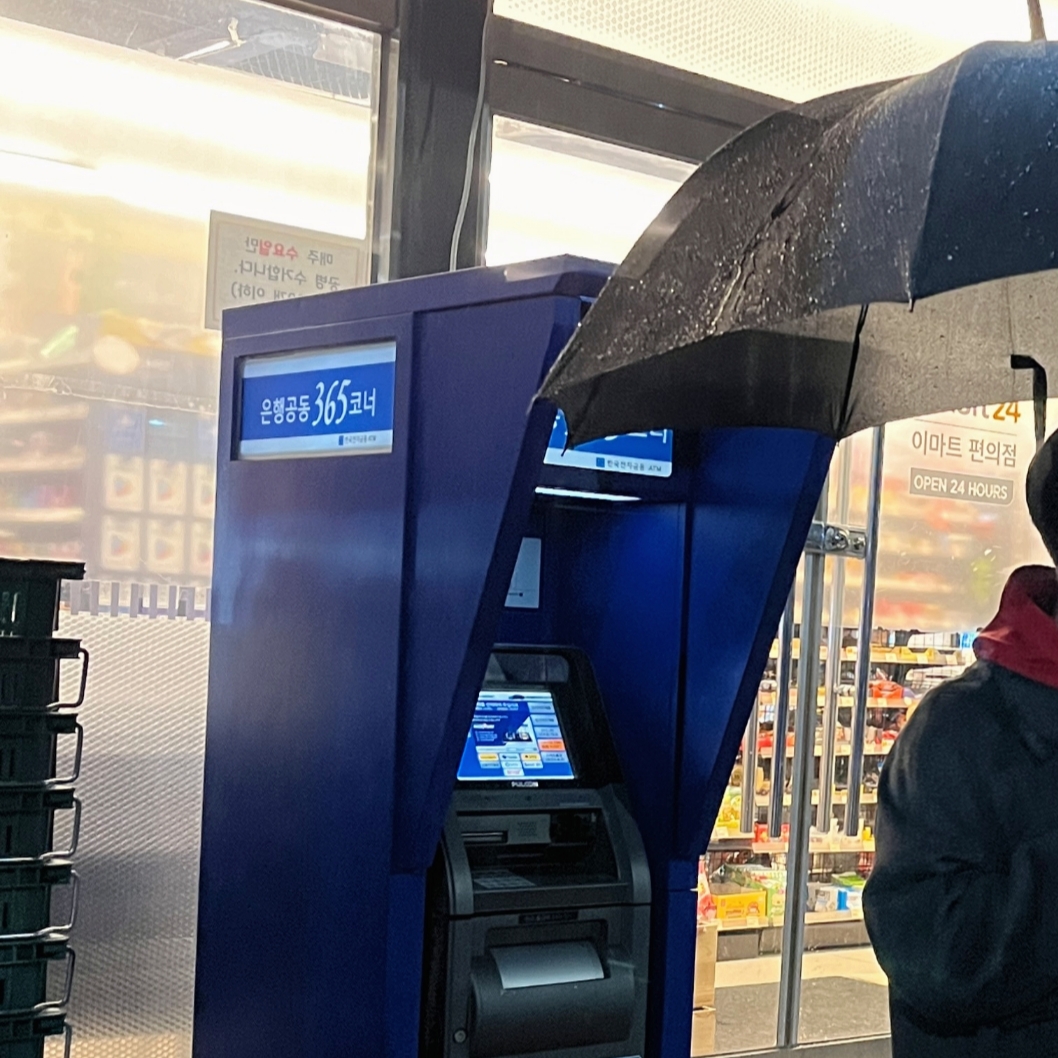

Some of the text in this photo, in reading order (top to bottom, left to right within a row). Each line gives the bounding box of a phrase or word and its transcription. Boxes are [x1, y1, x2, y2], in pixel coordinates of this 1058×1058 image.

[912, 430, 1017, 468] 이마트 편의점
[913, 474, 1008, 500] OPEN 24 HOURS
